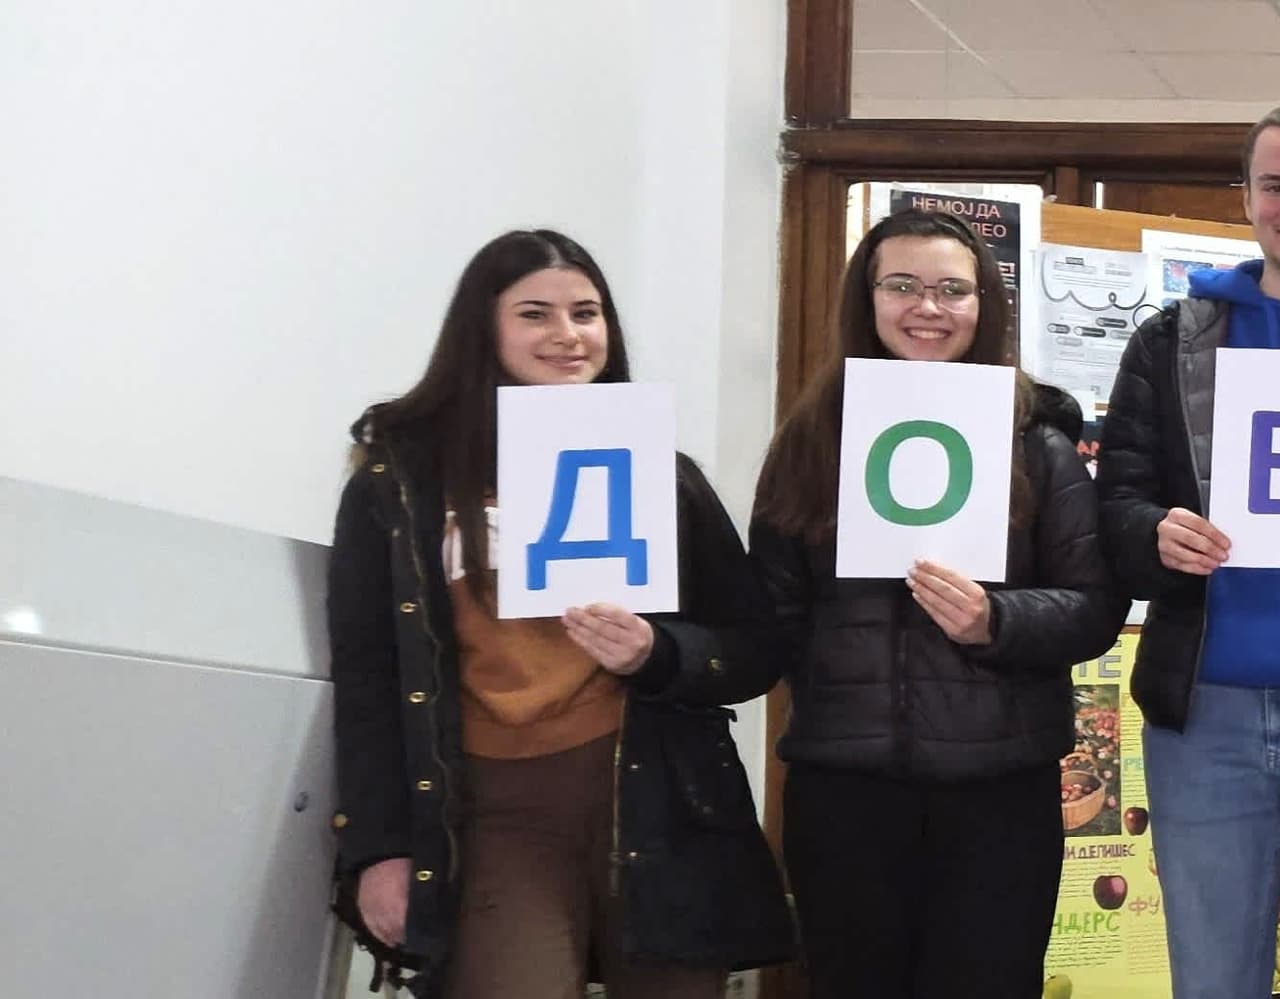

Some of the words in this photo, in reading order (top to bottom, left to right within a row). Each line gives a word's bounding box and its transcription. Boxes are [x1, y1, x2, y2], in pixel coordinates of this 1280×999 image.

[975, 202, 1001, 220] ДА
[527, 448, 648, 591] Д
[864, 419, 973, 527] О
